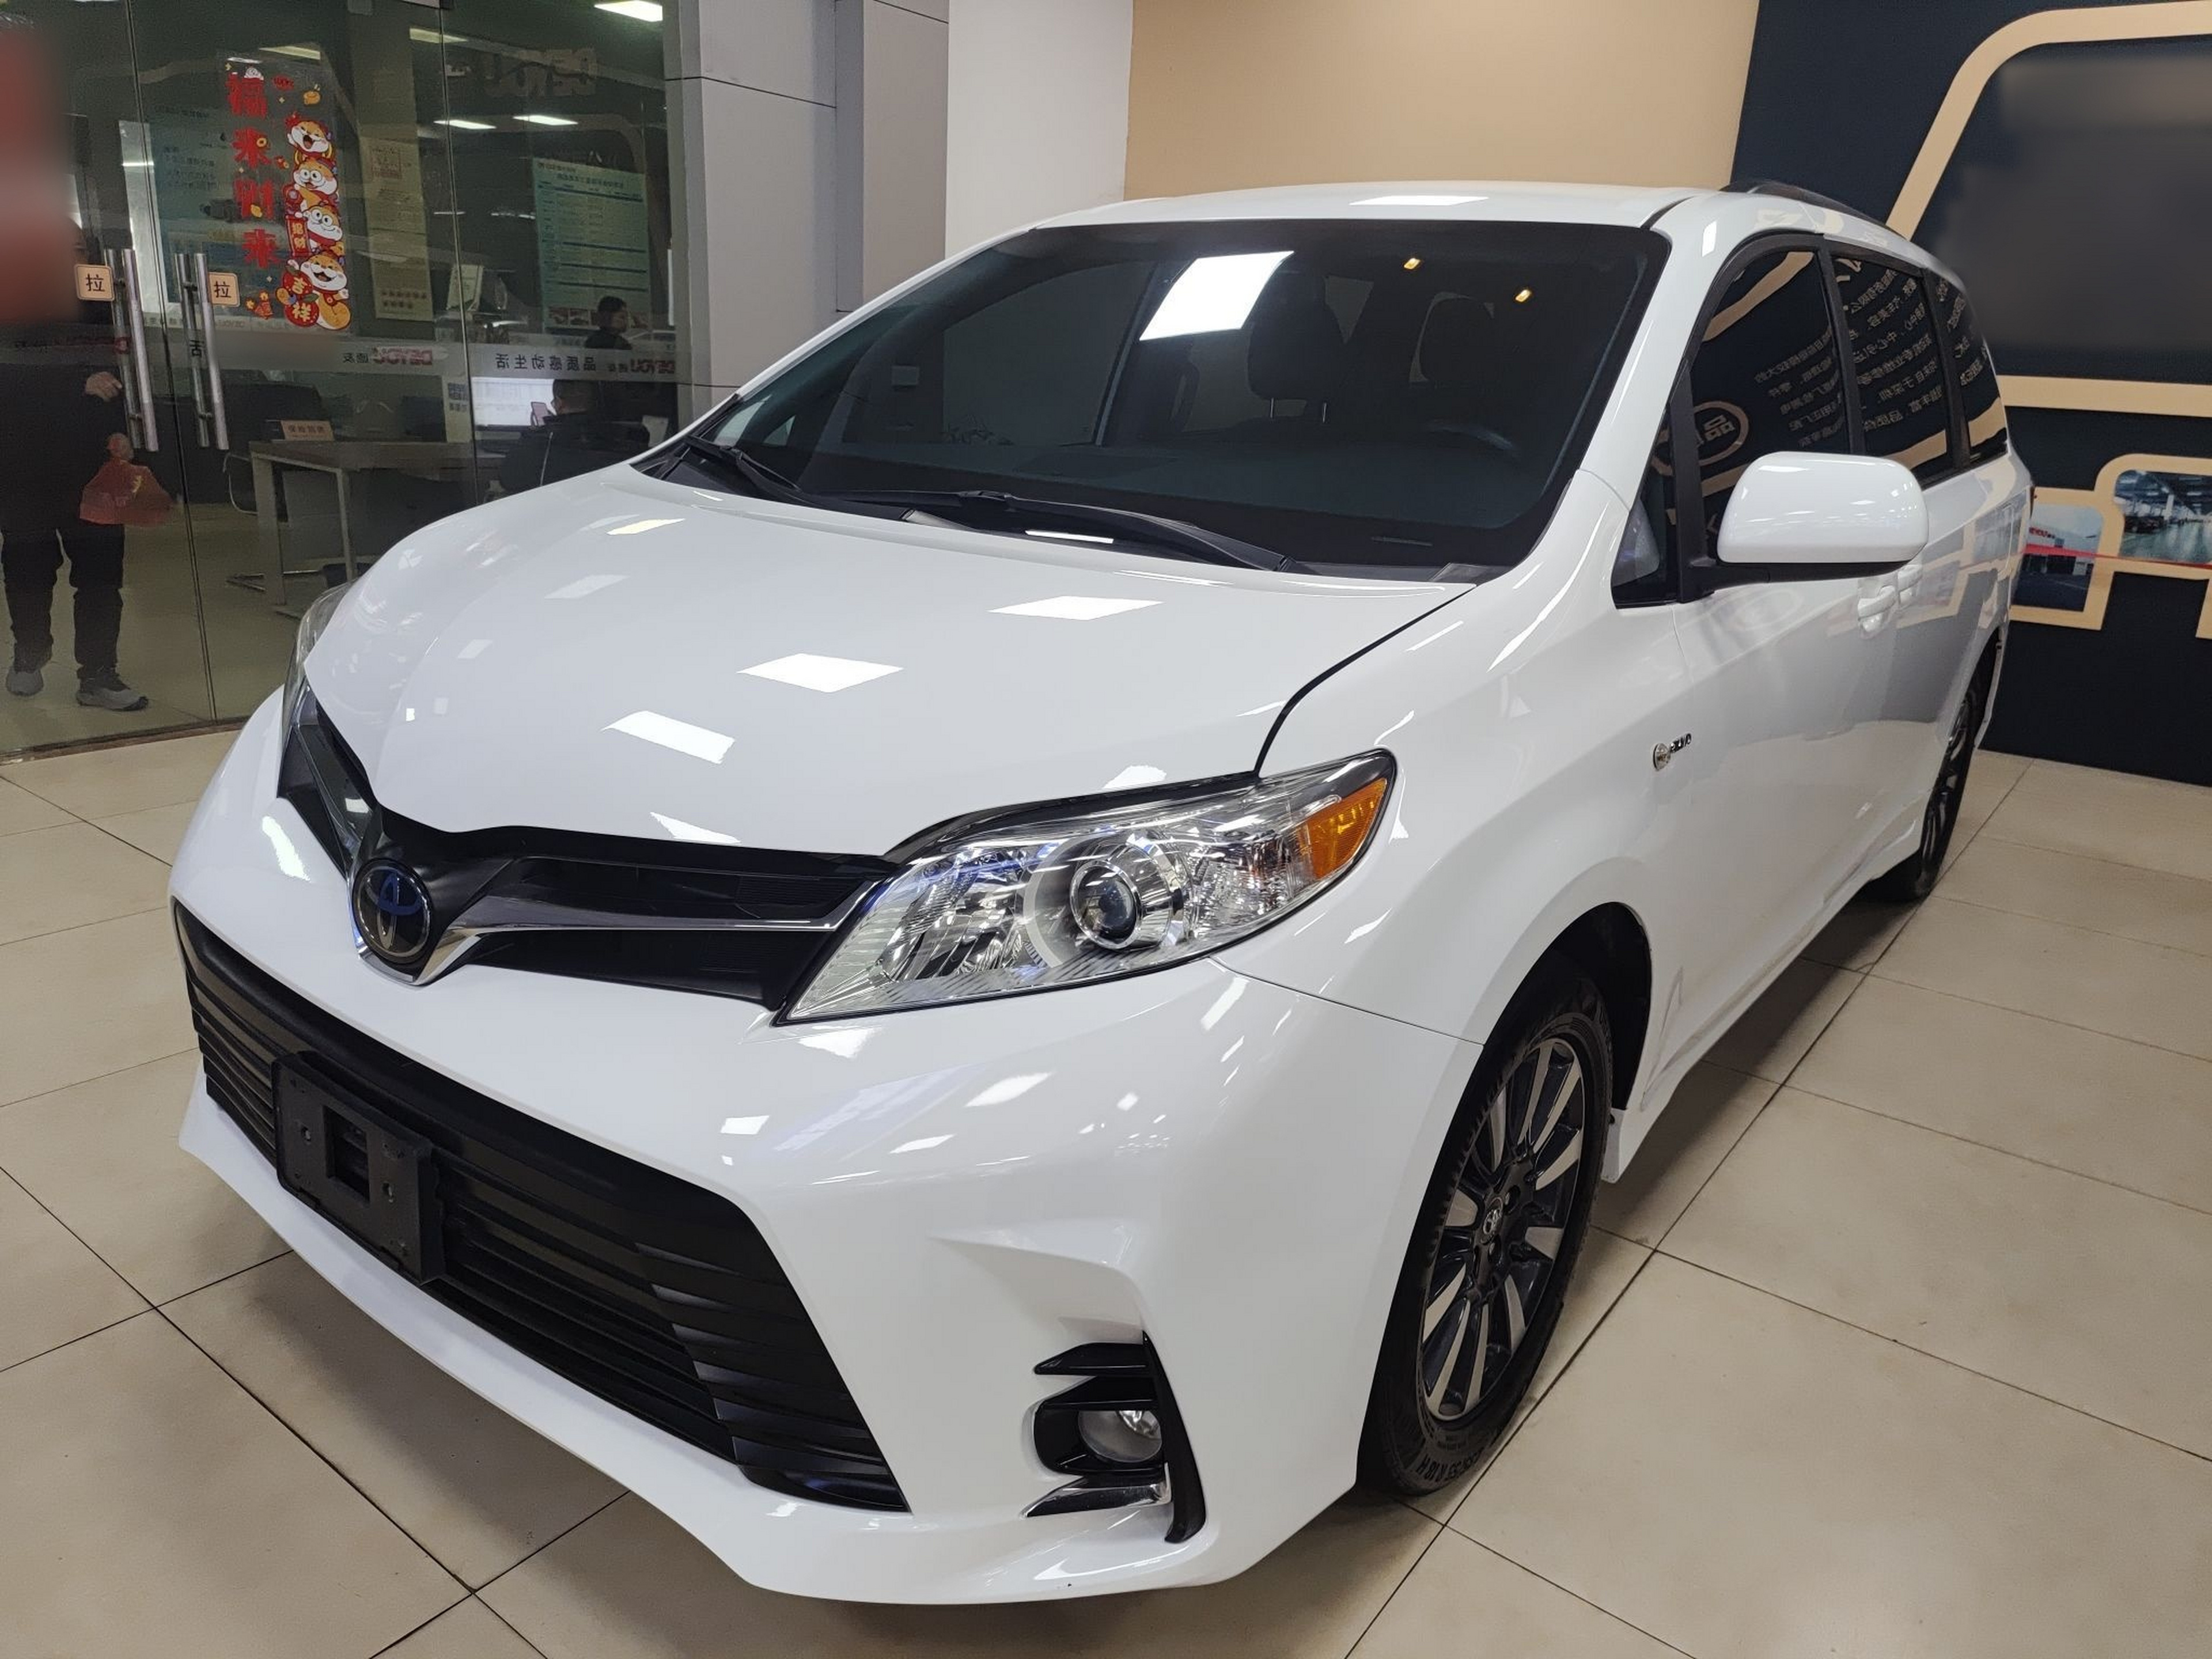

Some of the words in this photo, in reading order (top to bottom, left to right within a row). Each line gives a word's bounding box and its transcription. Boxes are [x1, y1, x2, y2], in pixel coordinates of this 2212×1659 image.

[85, 272, 105, 292] 拉
[213, 281, 232, 299] 拉
[291, 276, 312, 321] 吉祥
